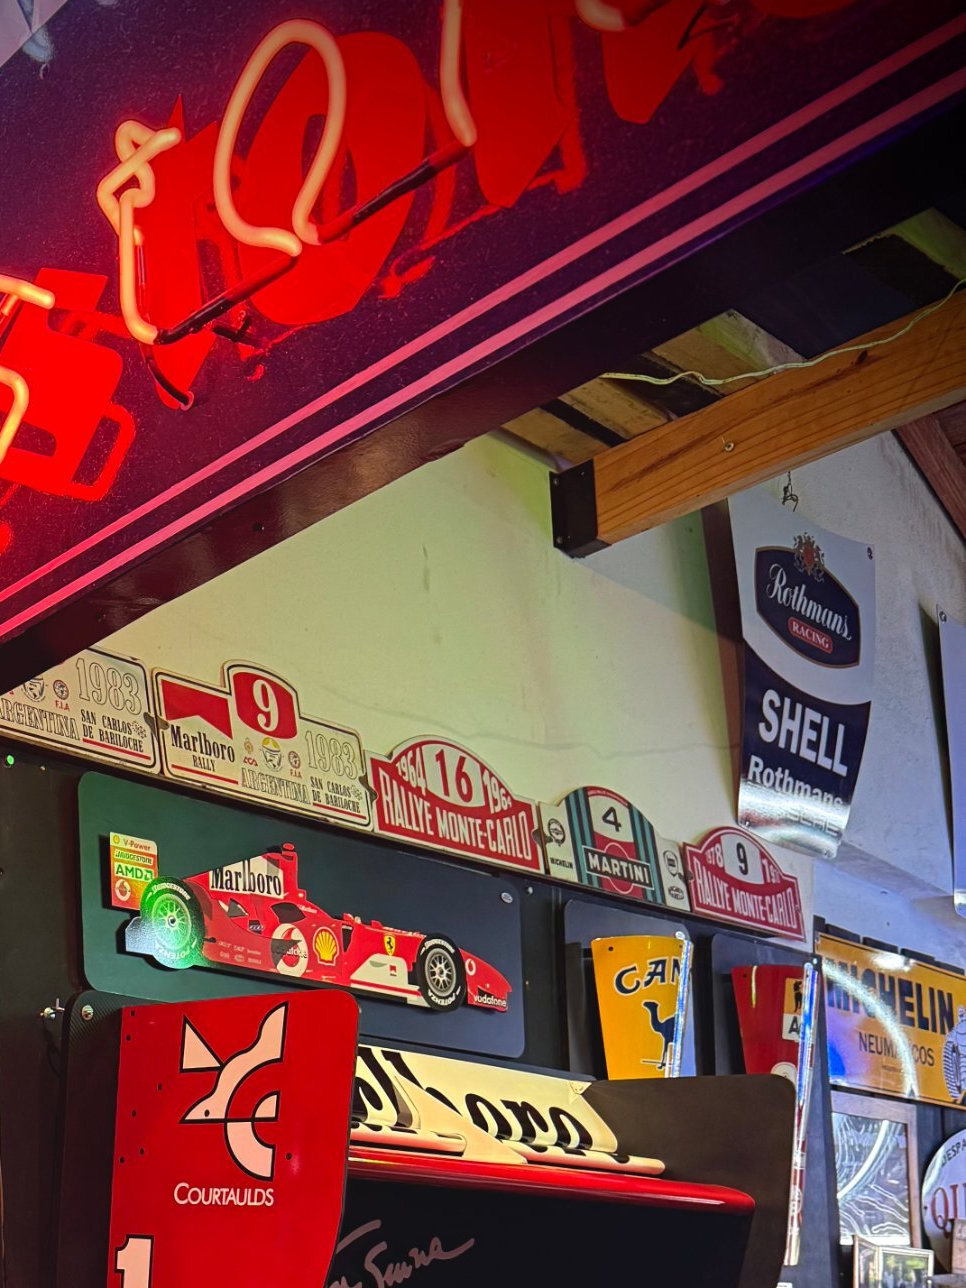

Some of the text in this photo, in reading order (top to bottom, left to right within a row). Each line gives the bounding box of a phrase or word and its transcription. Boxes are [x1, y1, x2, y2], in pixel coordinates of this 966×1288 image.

[766, 563, 852, 640] Rothmans
[791, 620, 831, 650] RACING
[75, 657, 143, 715] 1983
[80, 708, 133, 735] SAN CARLOS
[252, 679, 280, 732] 9
[82, 723, 144, 753] DE BARILOCHE
[170, 724, 236, 763] Marlboro
[757, 689, 848, 777] SHELL
[191, 754, 217, 772] RALLY
[305, 730, 359, 780] 1983
[241, 767, 312, 805] ARGENTINA
[310, 776, 352, 798] SAN CARLOS
[395, 746, 513, 815] 1964 16 1964
[312, 789, 362, 814] DE BARILOCHE
[378, 767, 533, 861] RALLYE MONTE-CARLO
[601, 806, 622, 832] 4
[123, 838, 151, 852] V-Power
[736, 842, 749, 875] 9
[115, 862, 143, 880] AMD
[210, 858, 283, 897] Marlboro
[587, 851, 652, 887] MARTINI
[693, 856, 797, 929] RALLYE MONTE-CARLO
[826, 957, 955, 1035] MICHELIN
[173, 1182, 275, 1207] COURTAULDS
